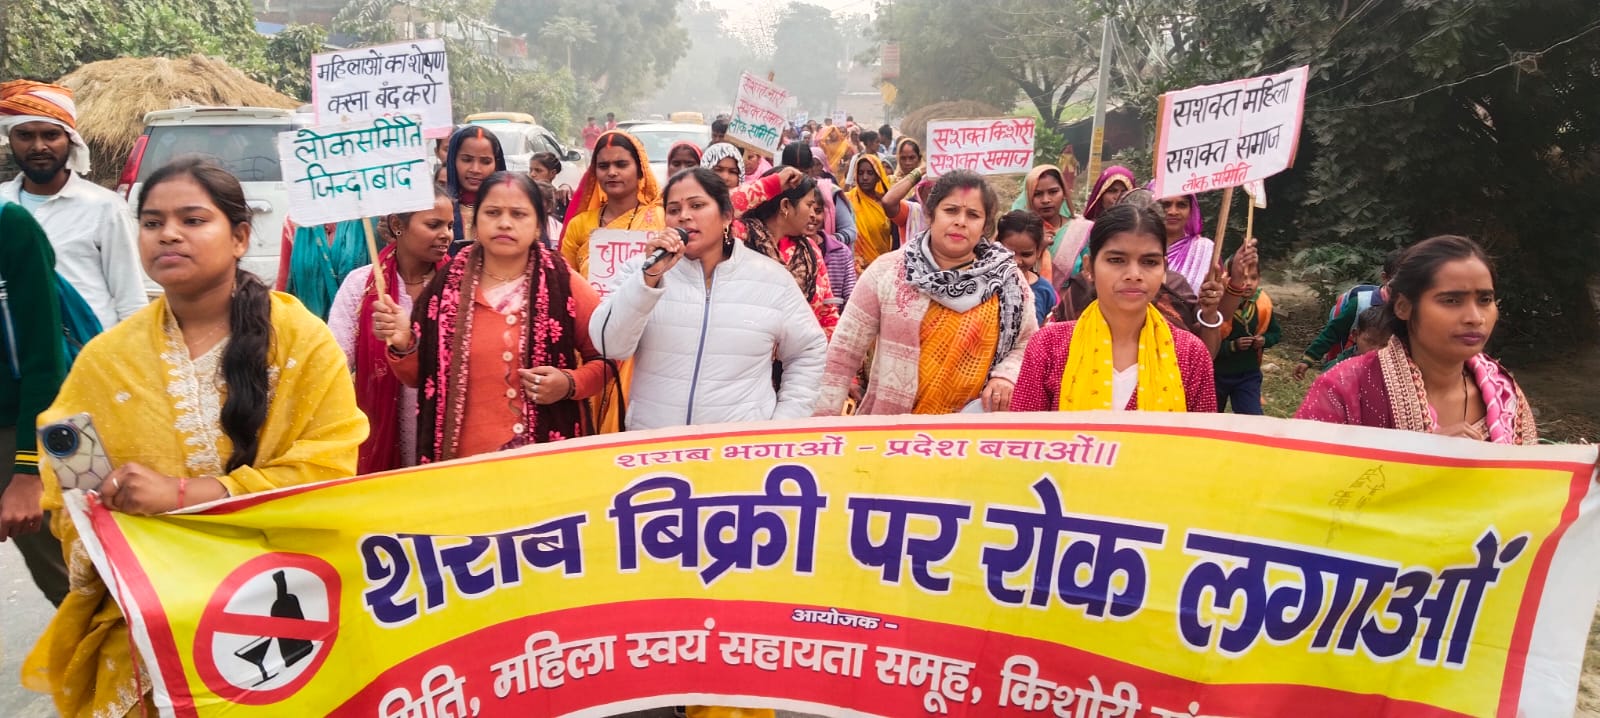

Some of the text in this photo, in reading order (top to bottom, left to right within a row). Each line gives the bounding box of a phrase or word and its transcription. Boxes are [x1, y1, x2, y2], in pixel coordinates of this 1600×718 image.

[317, 44, 445, 82] महिलाओं का शोषण
[375, 81, 403, 109] बंद
[402, 74, 443, 105] करो
[1173, 78, 1293, 127] सशक्त महिला
[933, 127, 988, 152] सशक्त
[1166, 124, 1284, 174] सशक्त समाज
[982, 149, 1034, 171] समाज
[616, 447, 712, 468] शराब
[723, 435, 844, 460] भगाओं
[885, 433, 970, 457] प्रदेश
[359, 463, 1531, 668] शराब बिक्री पर रोक लगाओं
[791, 607, 881, 629] आयोजक
[490, 631, 617, 698] महिला
[627, 617, 715, 669] स्वयं
[718, 632, 868, 679] सहायता
[874, 645, 983, 715] समूह,
